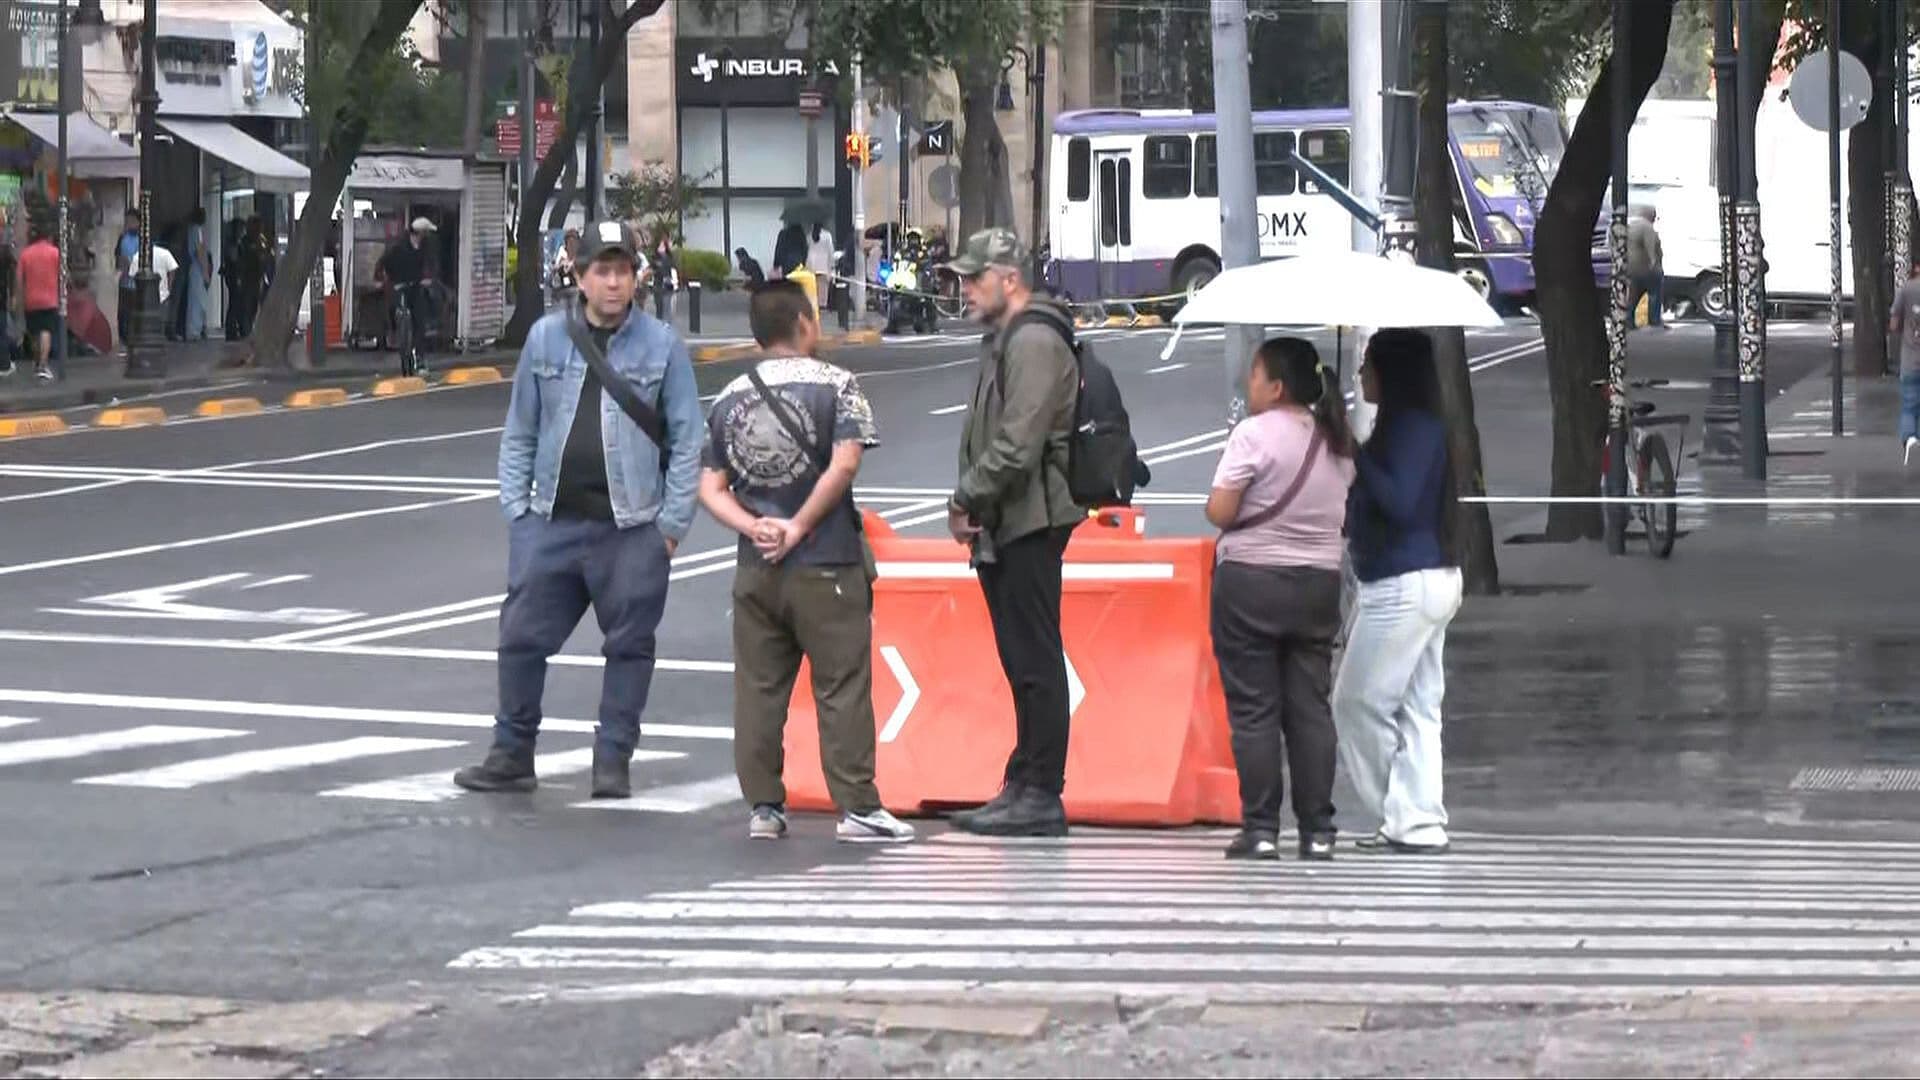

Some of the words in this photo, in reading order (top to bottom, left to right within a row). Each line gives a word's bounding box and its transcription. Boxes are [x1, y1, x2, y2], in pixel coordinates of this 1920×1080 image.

[721, 58, 841, 77] INBURA
[928, 134, 943, 149] N
[1257, 211, 1308, 238] DMX
